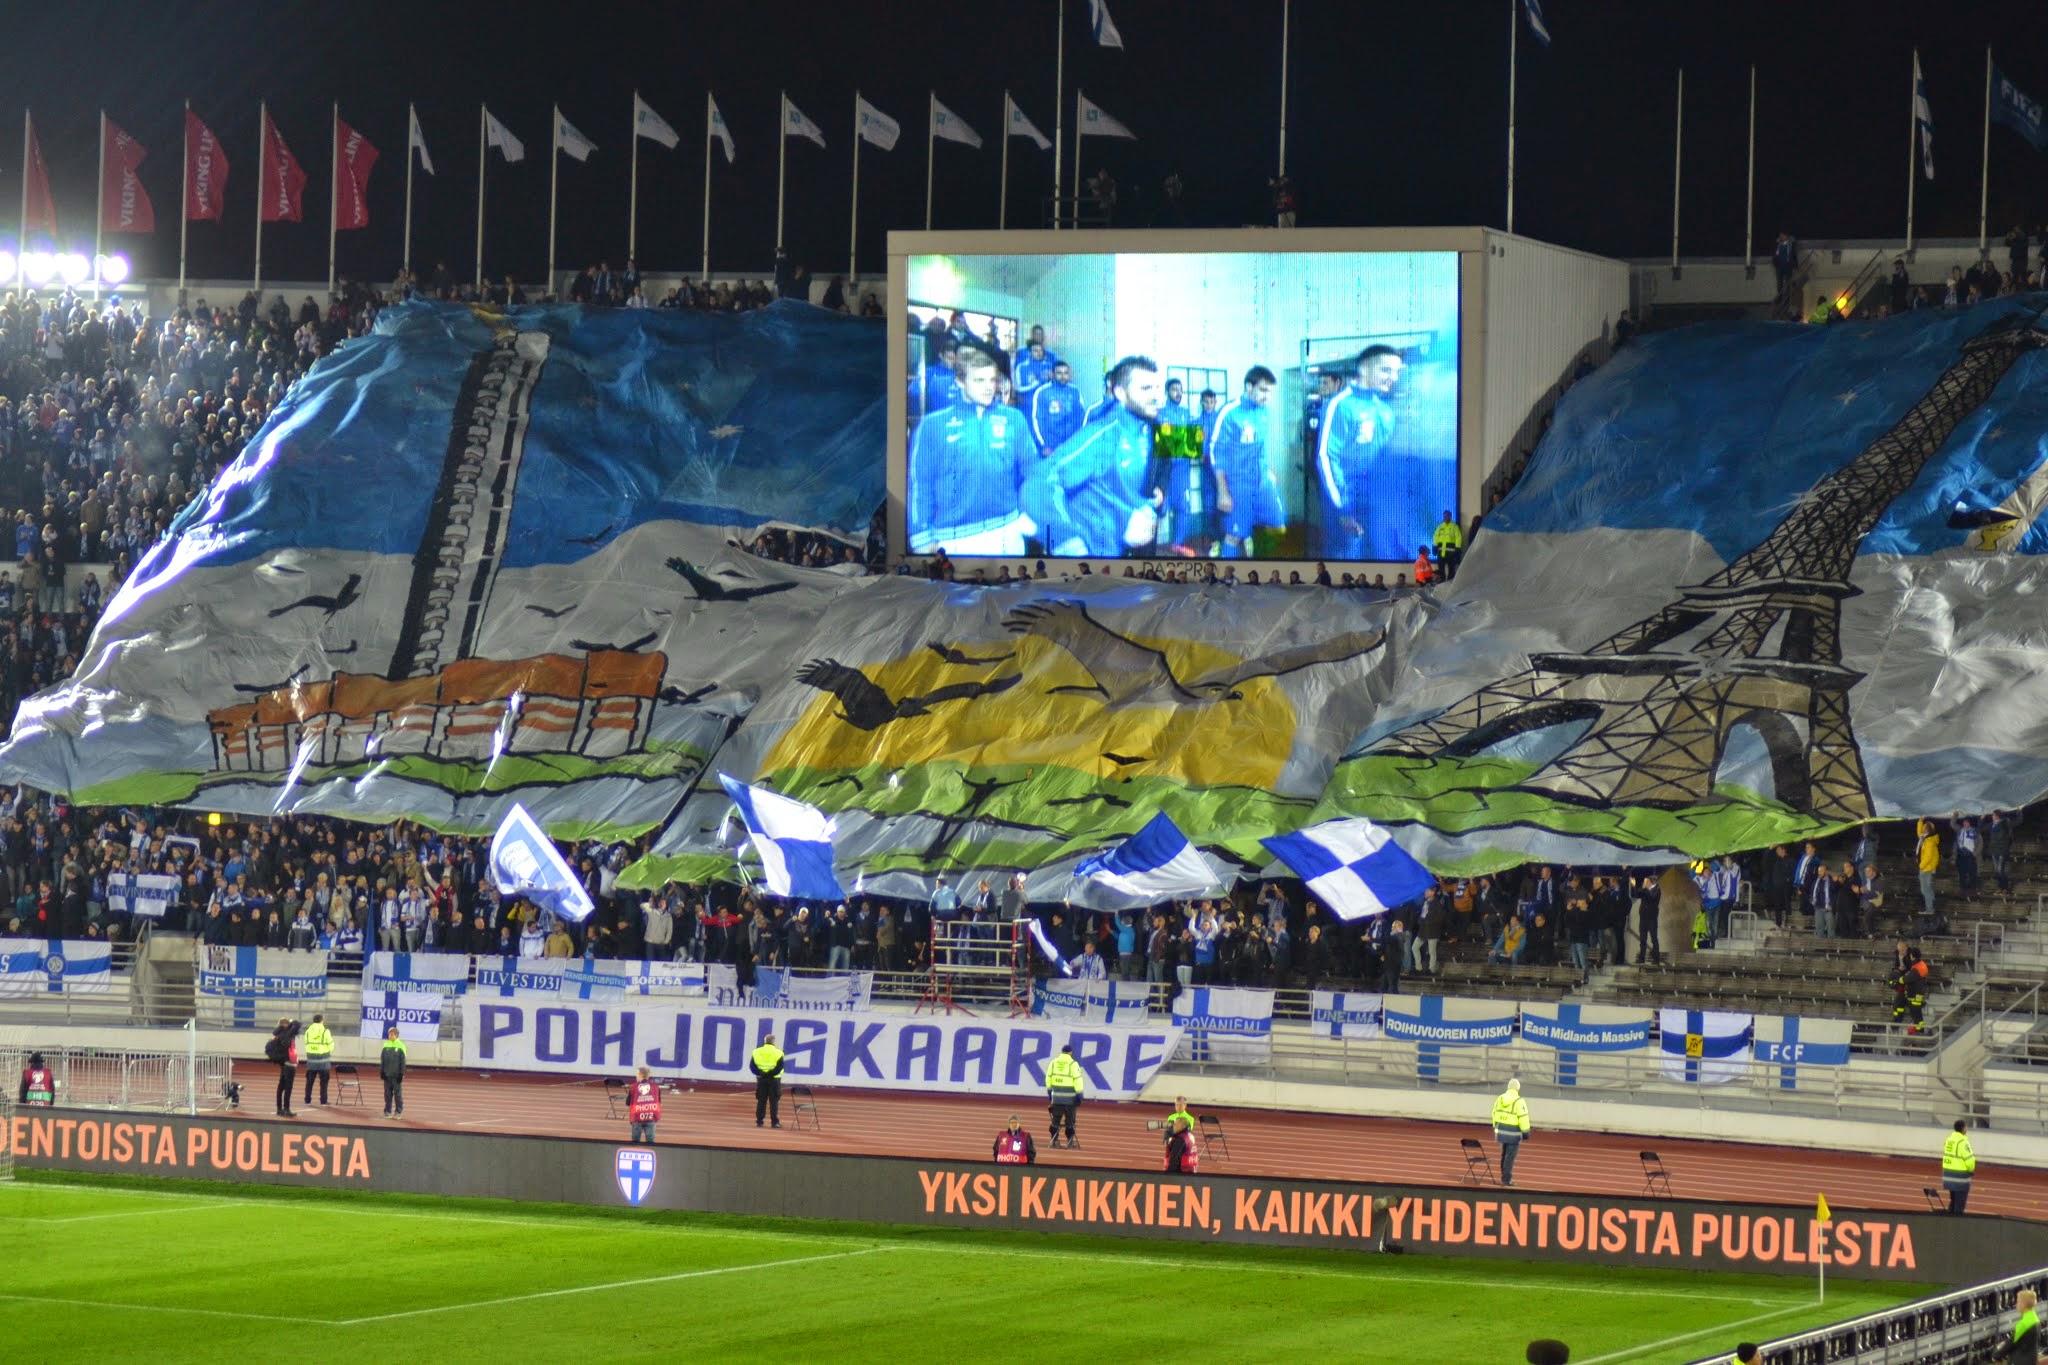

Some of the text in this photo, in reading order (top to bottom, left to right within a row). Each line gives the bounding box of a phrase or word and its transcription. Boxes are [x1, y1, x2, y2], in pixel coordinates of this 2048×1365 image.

[205, 976, 225, 992] FC
[271, 978, 323, 994] TURKU
[483, 969, 559, 991] ILVES 1931
[631, 976, 682, 986] BORTSA
[367, 1007, 431, 1023] RIXU BOYS
[1181, 1016, 1261, 1033] ROVANIEMI
[1317, 1009, 1375, 1025] UNELMA
[1386, 1018, 1512, 1041] ROIHUVUOREN RUISKU
[1524, 1021, 1646, 1044] East Midlands Massive
[479, 1004, 1167, 1092] POHJOISKAARRE
[1769, 1044, 1804, 1060] FCF
[186, 1126, 371, 1179] PUOLESTA
[918, 1171, 1916, 1269] YKSI KAIKKIEN, KAIKKI YHDENTOISTA PUOLESTA
